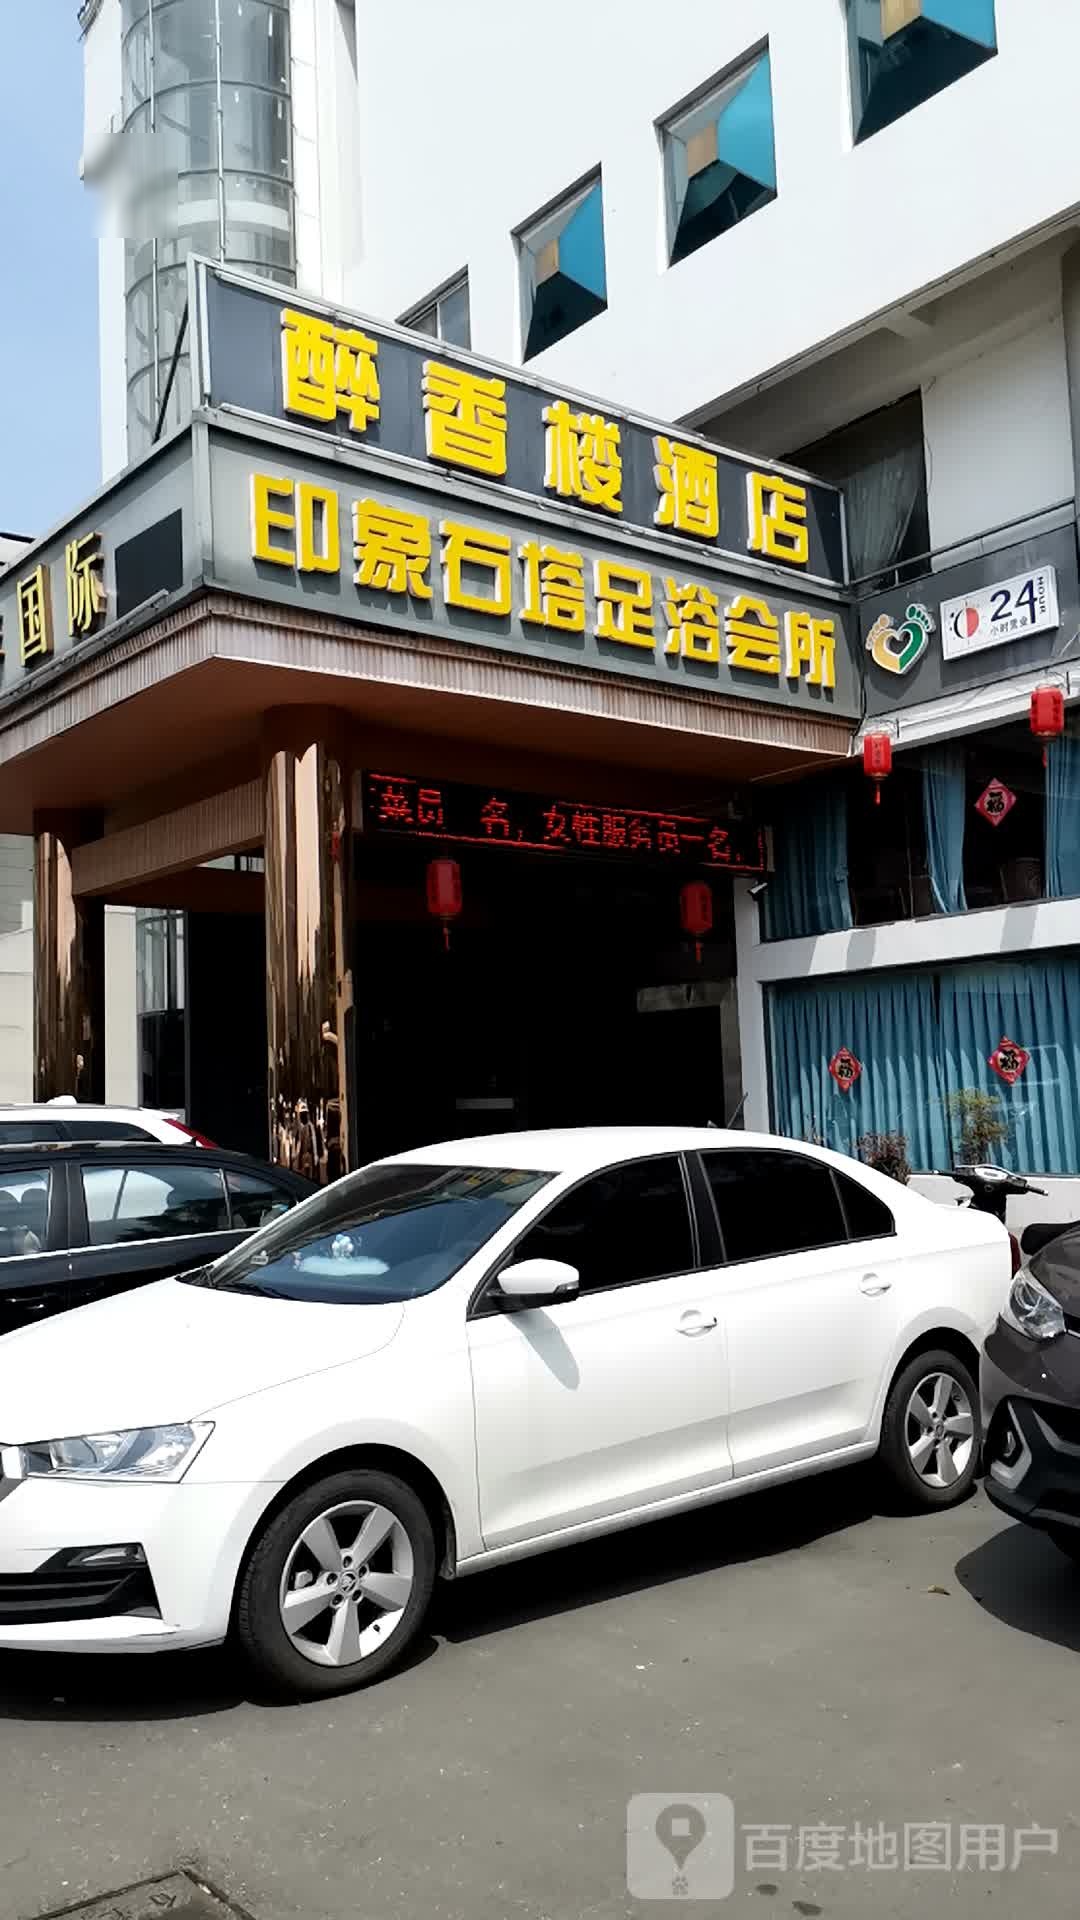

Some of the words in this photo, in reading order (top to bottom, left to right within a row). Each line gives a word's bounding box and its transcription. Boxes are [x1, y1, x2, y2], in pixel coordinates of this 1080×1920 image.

[280, 307, 809, 563] 醉香楼酒店
[0, 531, 104, 666] 国际
[249, 472, 836, 688] 印象石塔足浴会所
[990, 579, 1038, 624] 24
[1037, 576, 1048, 614] HOUR
[990, 616, 1028, 636] 小时营业
